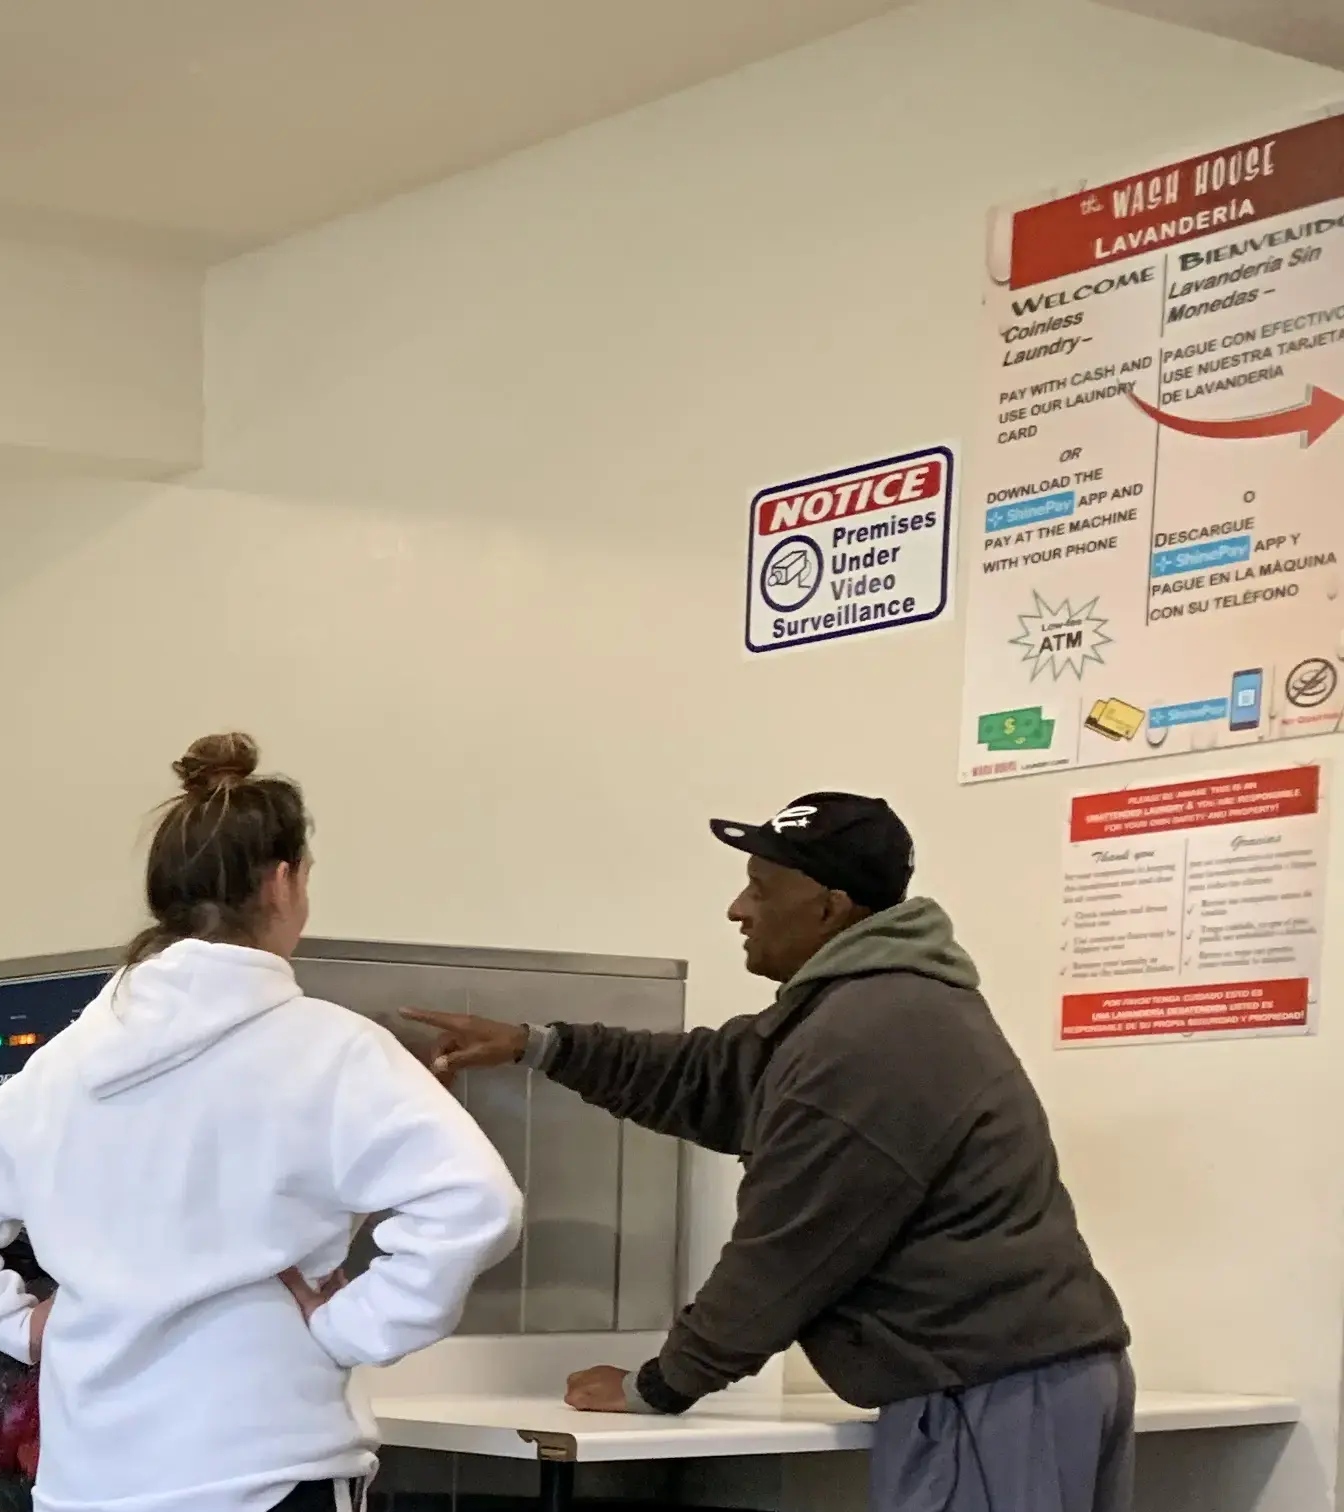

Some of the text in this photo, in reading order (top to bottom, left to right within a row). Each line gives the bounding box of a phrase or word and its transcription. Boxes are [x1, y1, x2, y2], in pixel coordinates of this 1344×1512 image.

[1113, 169, 1181, 219] WASH
[1195, 141, 1276, 197] HOUSE
[1095, 198, 1255, 259] LAVANDERÍA
[1168, 246, 1322, 300] Lavandería Sin
[1012, 266, 1155, 316] WELCOME
[1167, 288, 1259, 323] Monedas
[1003, 311, 1084, 343] Coinless
[1163, 339, 1217, 363] PAGUE
[1221, 329, 1256, 348] CON
[1163, 327, 1344, 384] USE NUESTRA TARJETA
[1000, 356, 1153, 404] PAY WITH CASH AND
[1162, 364, 1284, 405] DE LAVANDERÍA
[999, 380, 1136, 424] USE OUR LAUNDRY
[998, 425, 1038, 444] CARD
[1059, 447, 1083, 463] OR
[770, 466, 929, 531] NOTICE
[987, 467, 1103, 504] DOWNLOAD THE
[1077, 491, 1107, 507] APP
[1111, 483, 1144, 500] AND
[1243, 491, 1255, 503] O
[833, 512, 936, 548] Premises
[985, 508, 1138, 551] PAY AT THE MACHINE
[1254, 535, 1287, 553] APP
[1290, 533, 1300, 546] Y
[832, 546, 901, 574] Under
[983, 536, 1117, 574] WITH YOUR PHONE
[831, 574, 896, 601] Video
[1152, 576, 1205, 596] PAGUE
[1209, 571, 1230, 586] EN
[1235, 568, 1255, 581] LA
[773, 597, 915, 639] Surveillance
[1151, 605, 1183, 621] CON
[1188, 602, 1209, 615] SU
[1039, 630, 1082, 653] ATM
[1092, 849, 1156, 863] Thank you
